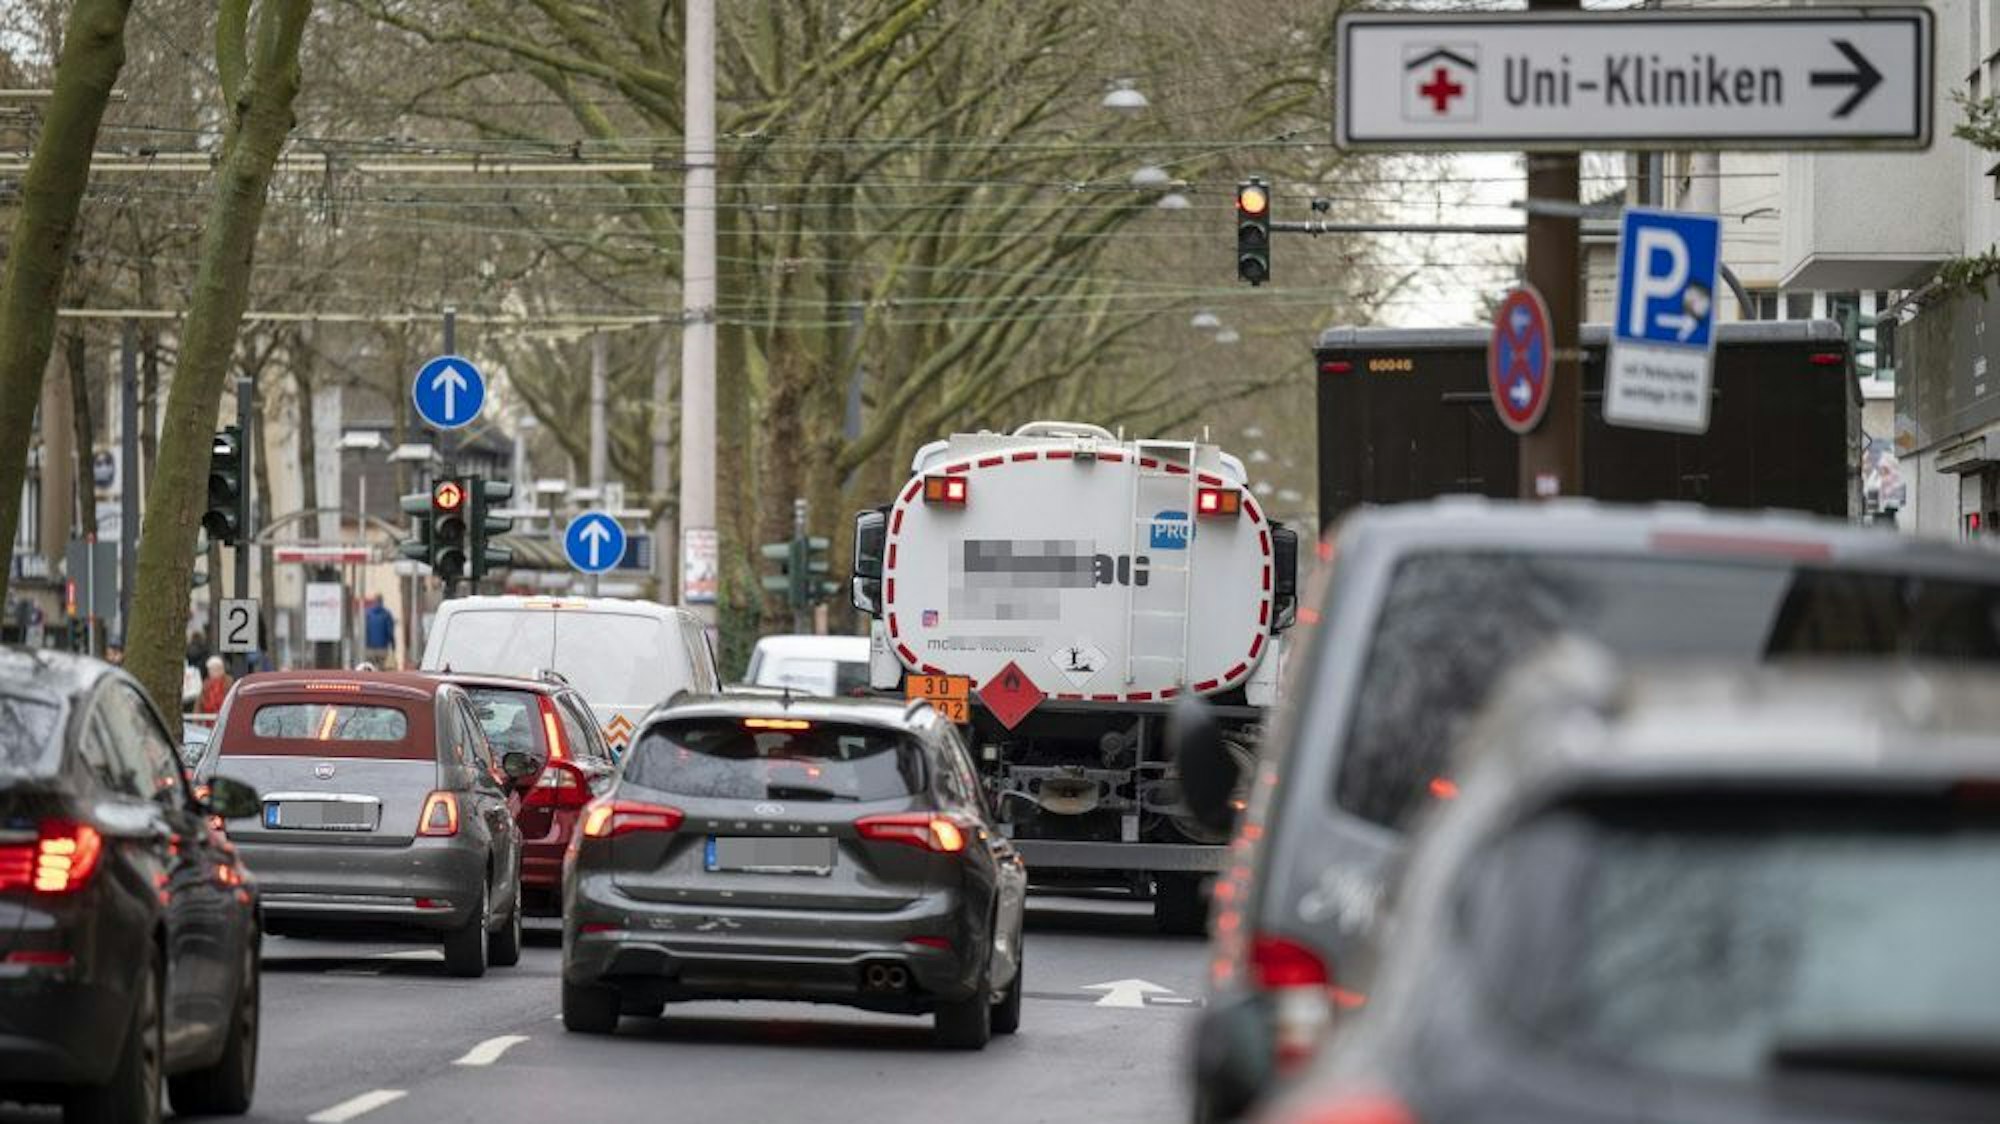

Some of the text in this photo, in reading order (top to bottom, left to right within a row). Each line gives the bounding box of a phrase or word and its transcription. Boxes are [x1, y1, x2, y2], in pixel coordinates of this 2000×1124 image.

[1505, 54, 1783, 106] Uni-Kliniken
[1630, 227, 1689, 337] P
[229, 608, 248, 644] 2
[925, 678, 948, 695] 30
